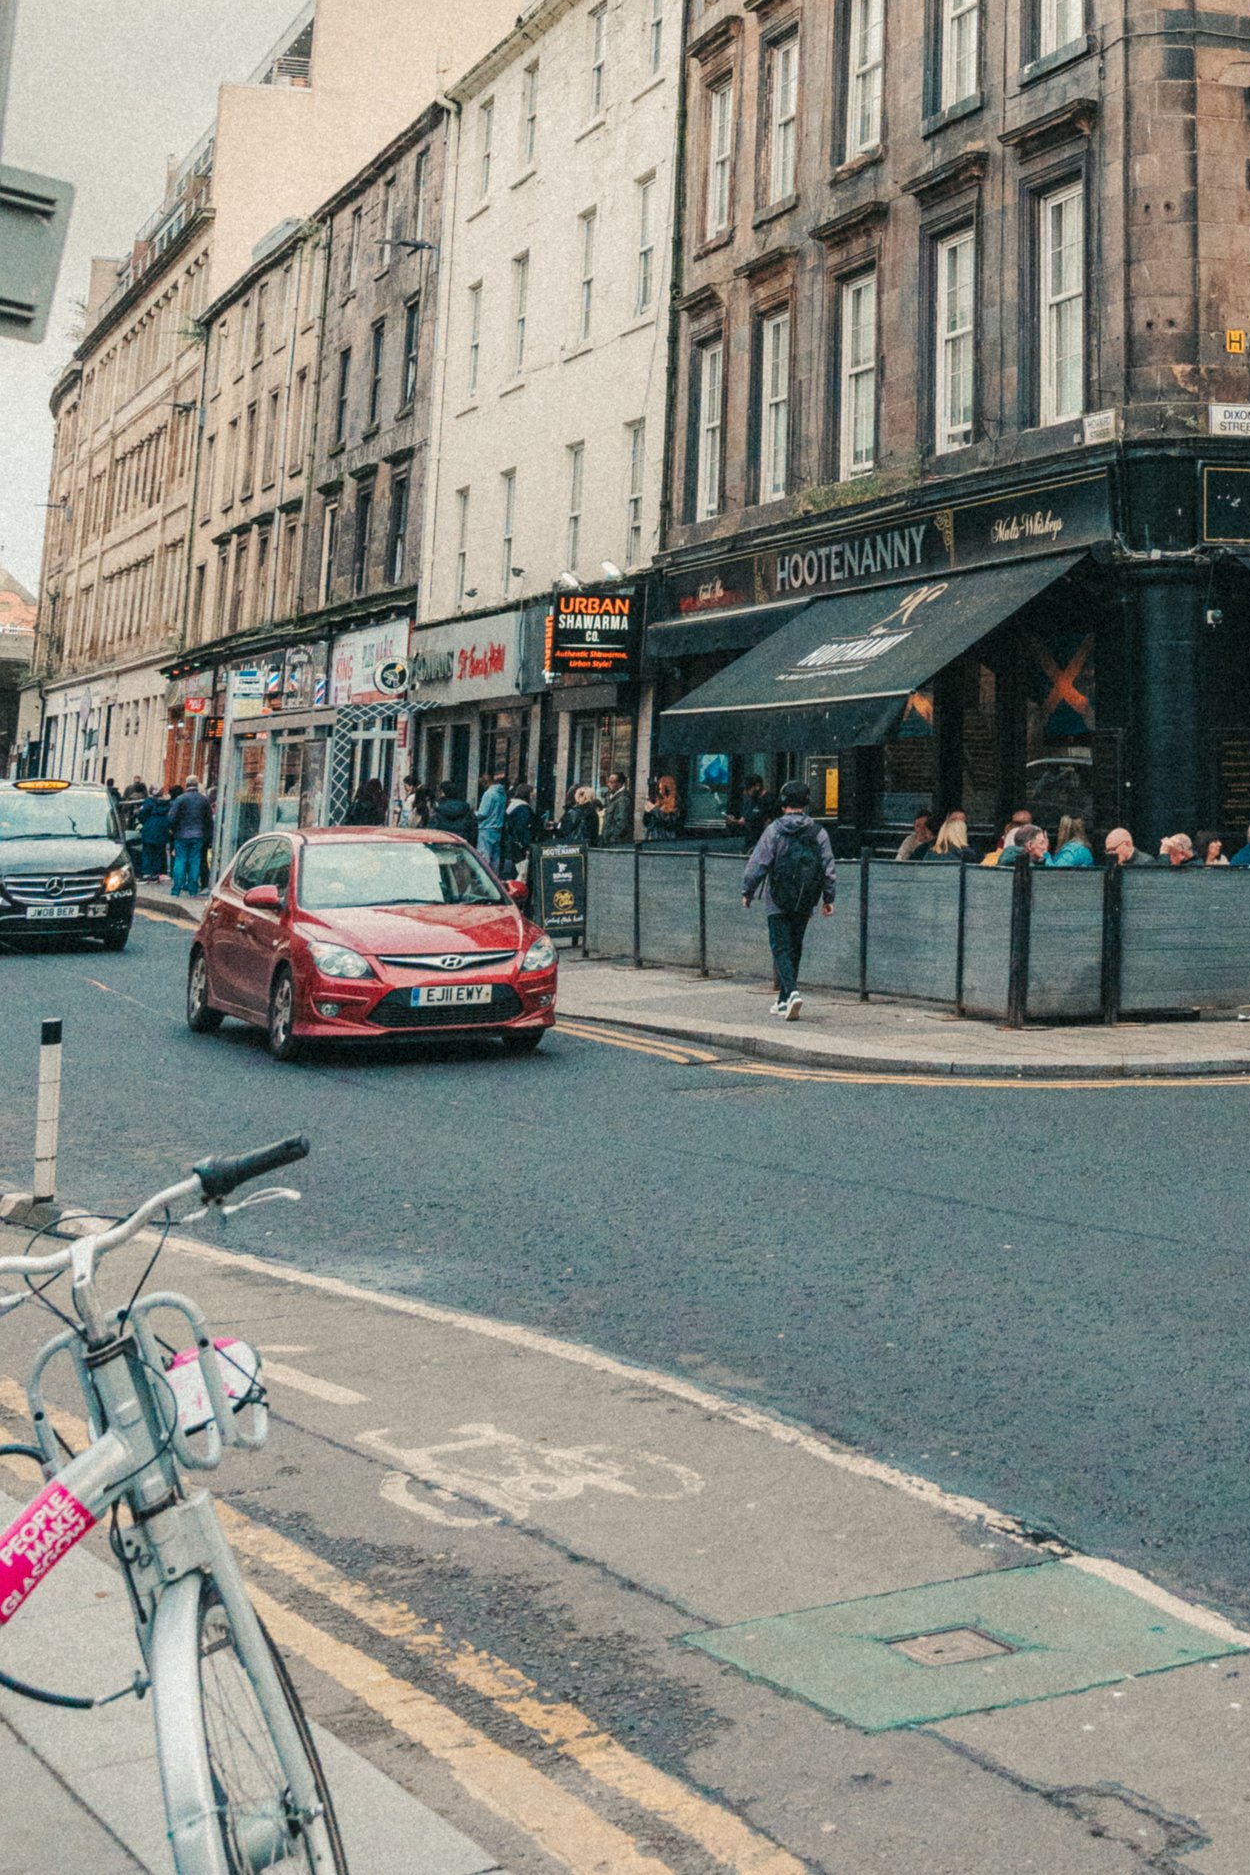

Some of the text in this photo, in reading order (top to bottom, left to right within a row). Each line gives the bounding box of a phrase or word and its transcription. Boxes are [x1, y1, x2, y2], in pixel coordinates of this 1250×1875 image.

[1229, 332, 1242, 351] H
[776, 524, 927, 592] HOOTENANNY
[560, 597, 630, 615] URBAN
[558, 614, 629, 630] SHAWARMA
[585, 630, 600, 642] CO.
[555, 650, 589, 659] Authentic
[569, 660, 591, 668] Urban
[56, 906, 75, 917] BER
[426, 986, 483, 1003] EJ11 EWY
[0, 1491, 73, 1567] PEOPLE
[25, 1506, 80, 1565] MAKE
[0, 1515, 86, 1616] GLASGOW
